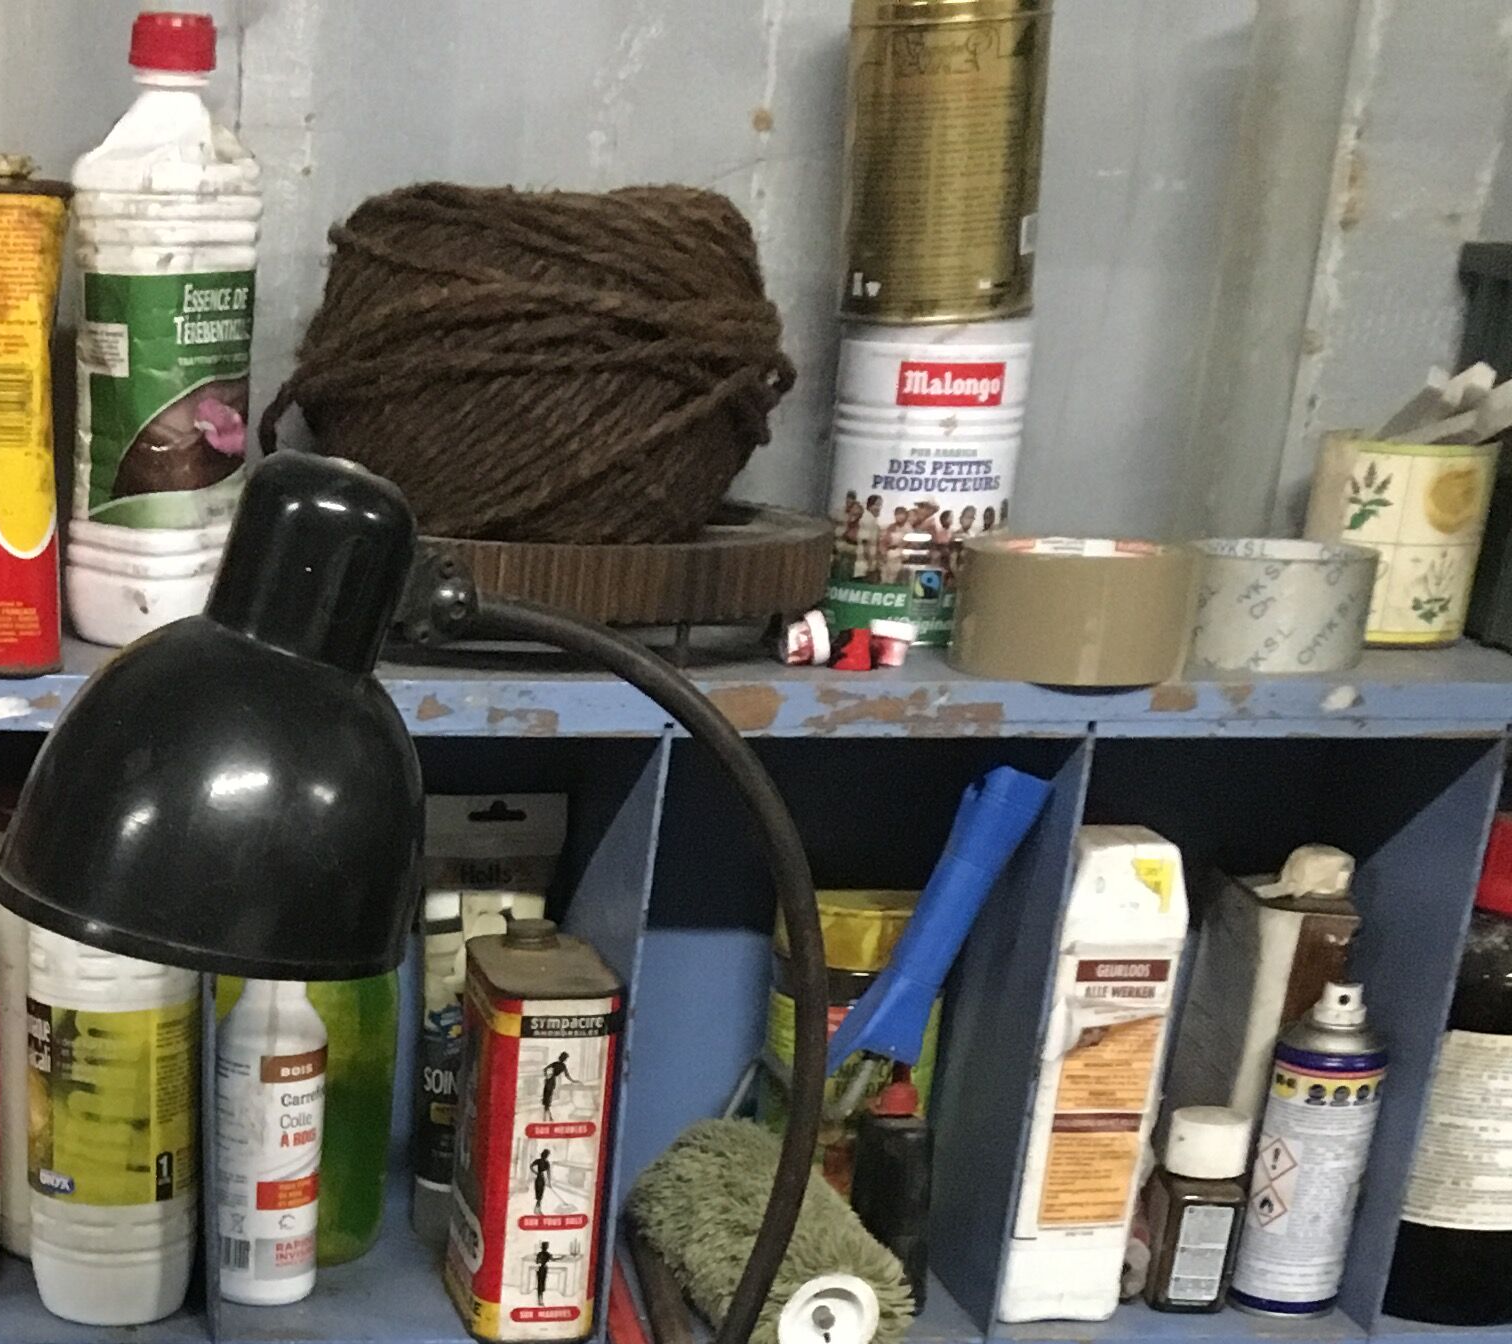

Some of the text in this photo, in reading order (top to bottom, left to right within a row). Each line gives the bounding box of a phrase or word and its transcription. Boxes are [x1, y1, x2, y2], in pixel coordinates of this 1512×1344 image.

[904, 369, 1001, 402] Malongo
[889, 459, 993, 477] DES PETITS
[871, 474, 1001, 493] PRODUCTEURS
[280, 1063, 314, 1078] BOIS
[280, 1112, 313, 1131] Colle
[293, 1127, 317, 1146] BOIS
[158, 1155, 170, 1177] 1
